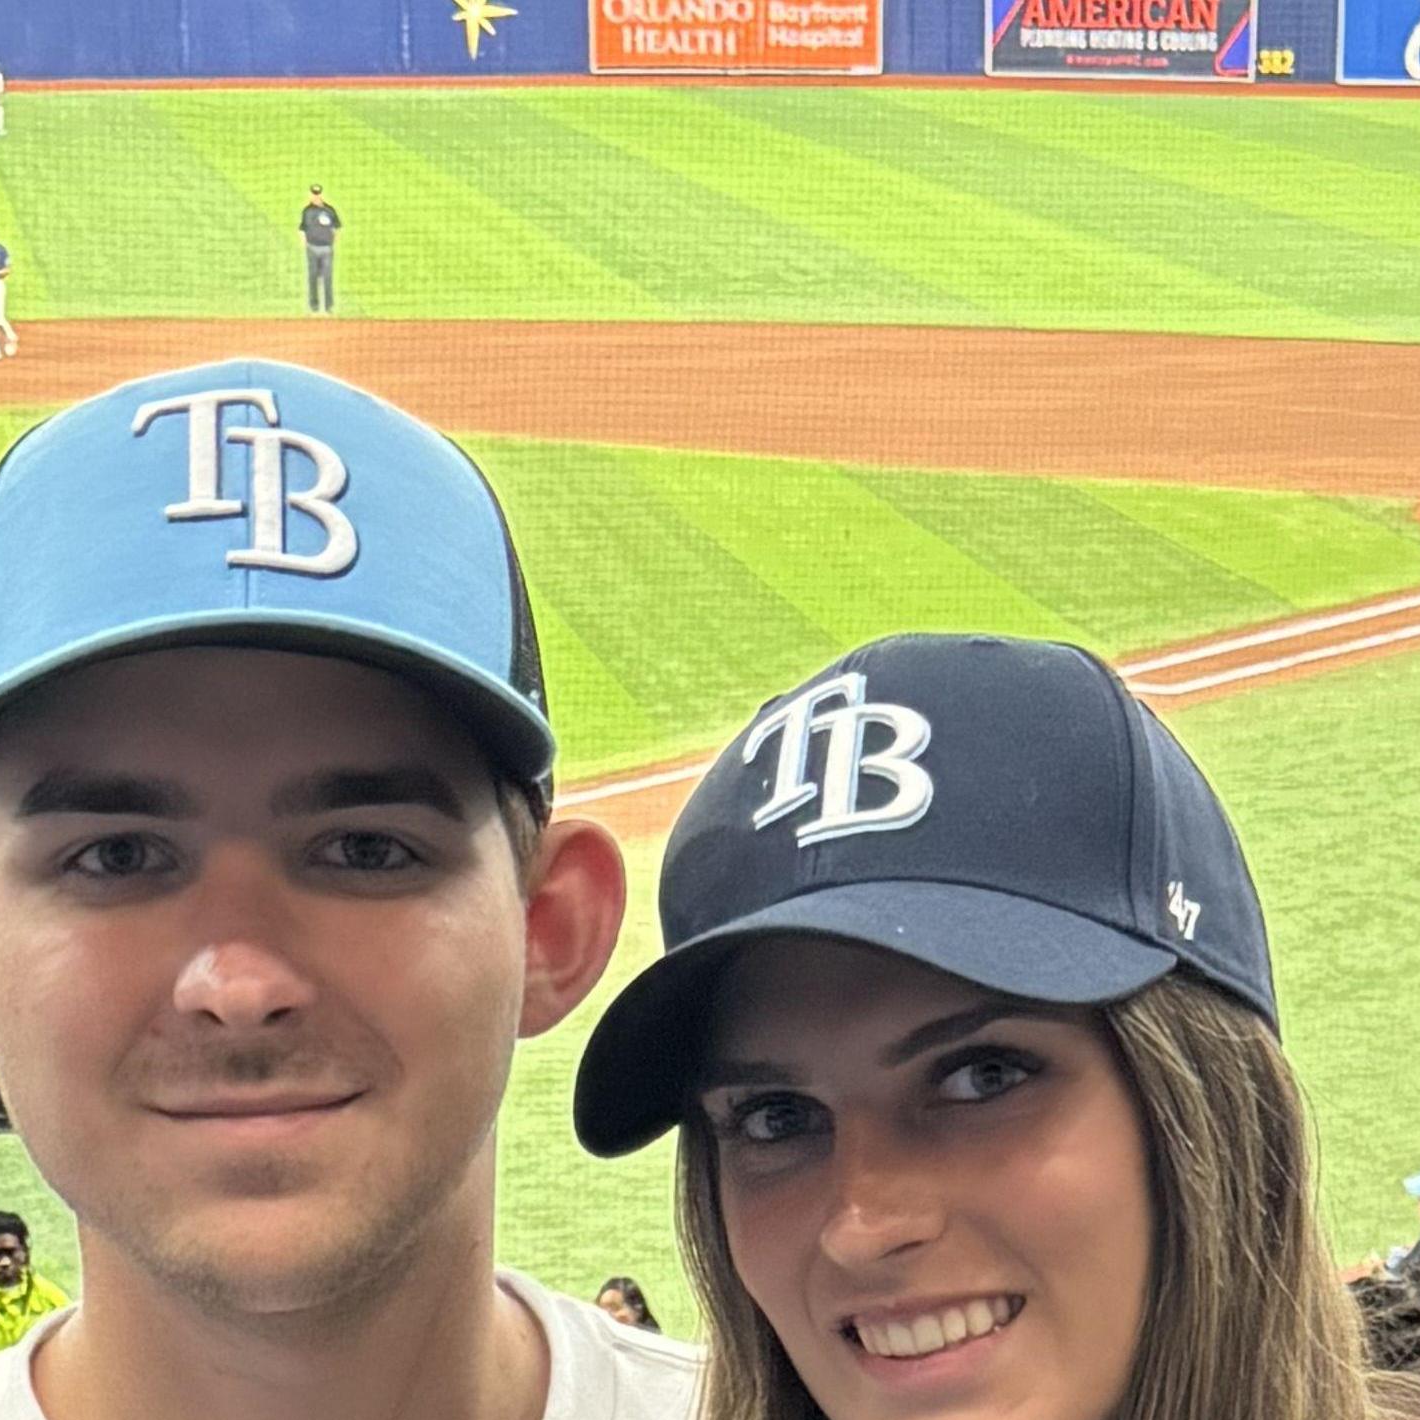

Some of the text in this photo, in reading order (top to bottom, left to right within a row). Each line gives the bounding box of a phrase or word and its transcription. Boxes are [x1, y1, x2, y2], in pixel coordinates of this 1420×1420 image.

[602, 0, 754, 23] ORLANDO
[1021, 0, 1219, 29] AMERICAN
[622, 25, 737, 55] HEALTH
[131, 388, 360, 580] TB
[742, 672, 934, 848] TB
